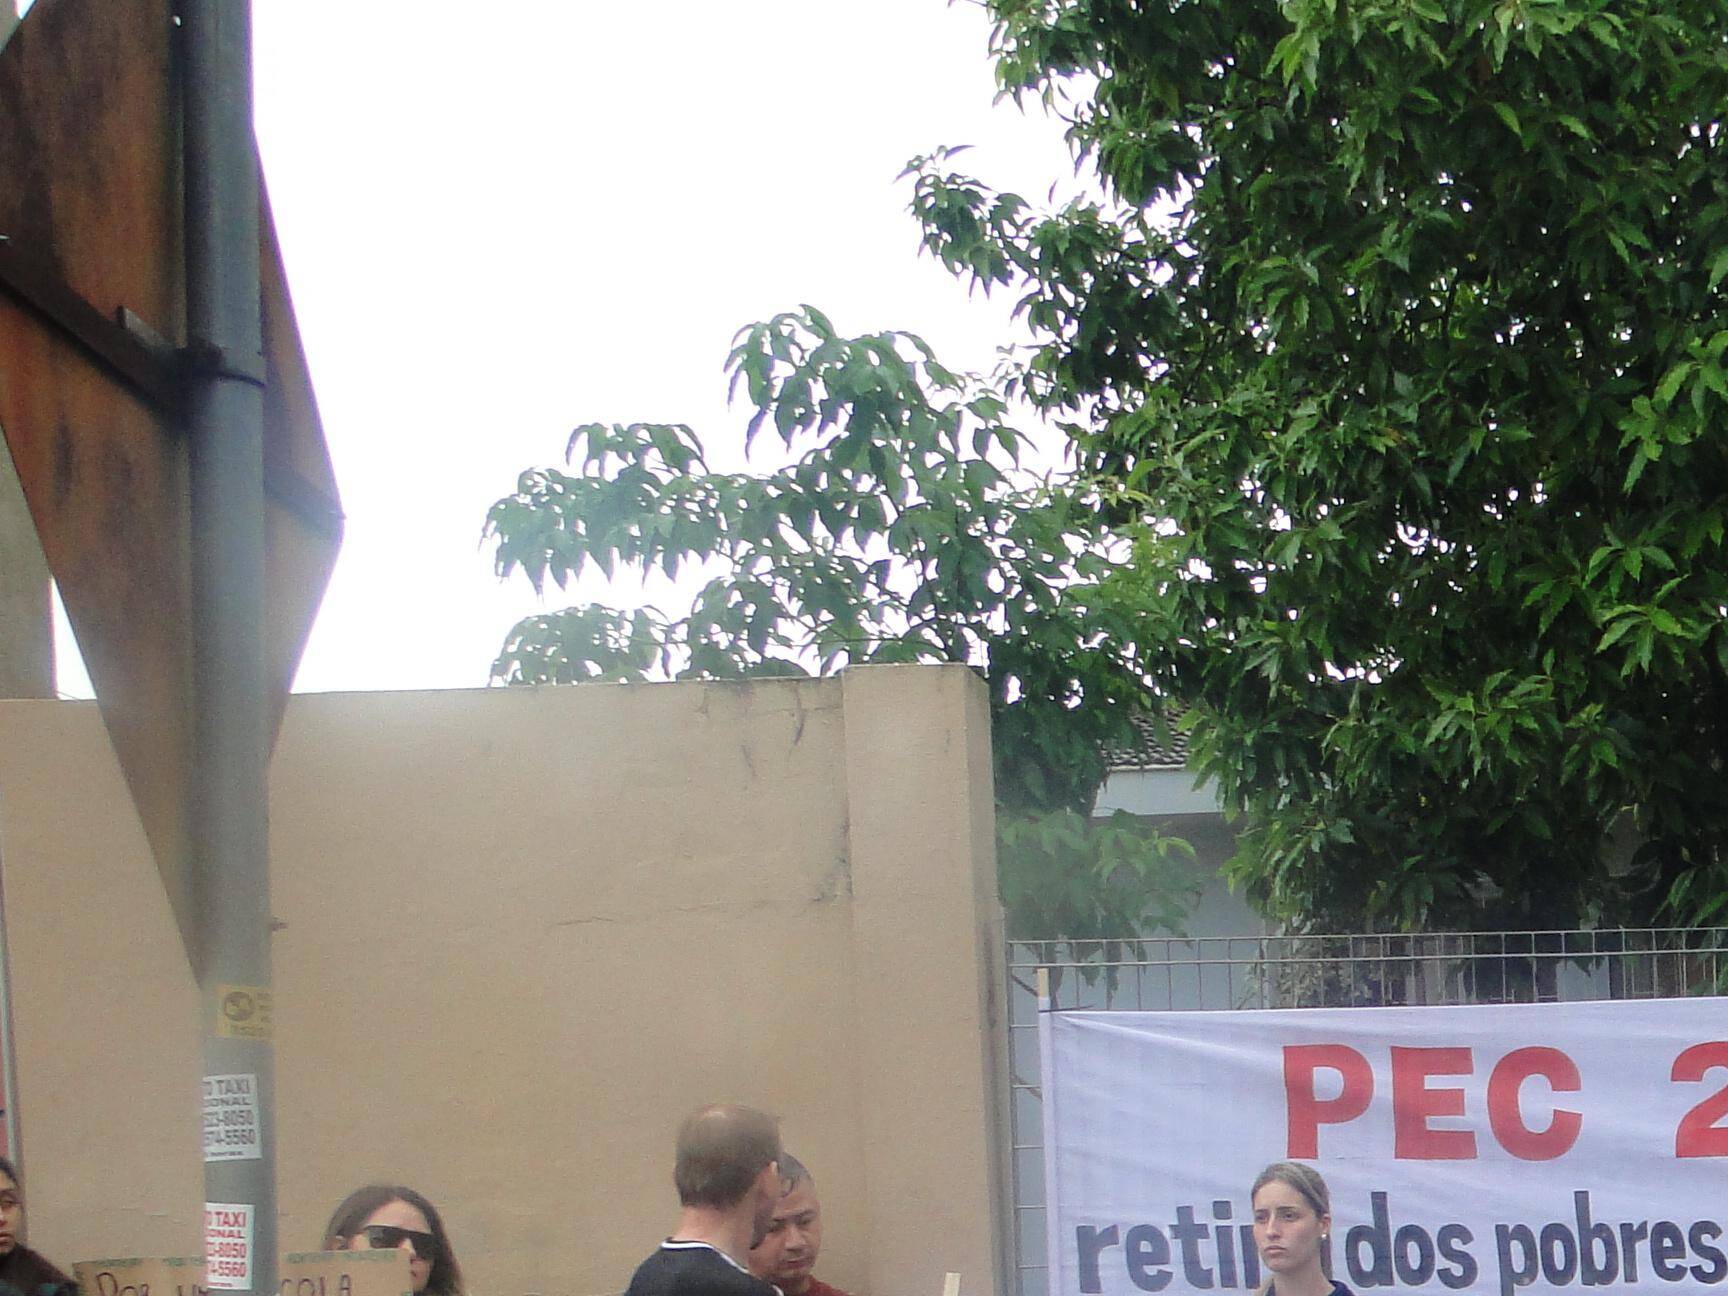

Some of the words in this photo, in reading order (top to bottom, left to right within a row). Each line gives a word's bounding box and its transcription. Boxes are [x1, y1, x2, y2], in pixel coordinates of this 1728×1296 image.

[217, 1079, 250, 1095] TAXI
[1282, 1043, 1583, 1161] PEC
[214, 1211, 246, 1228] TAXI
[1075, 1199, 1333, 1294] retir
[1345, 1191, 1479, 1289] dos
